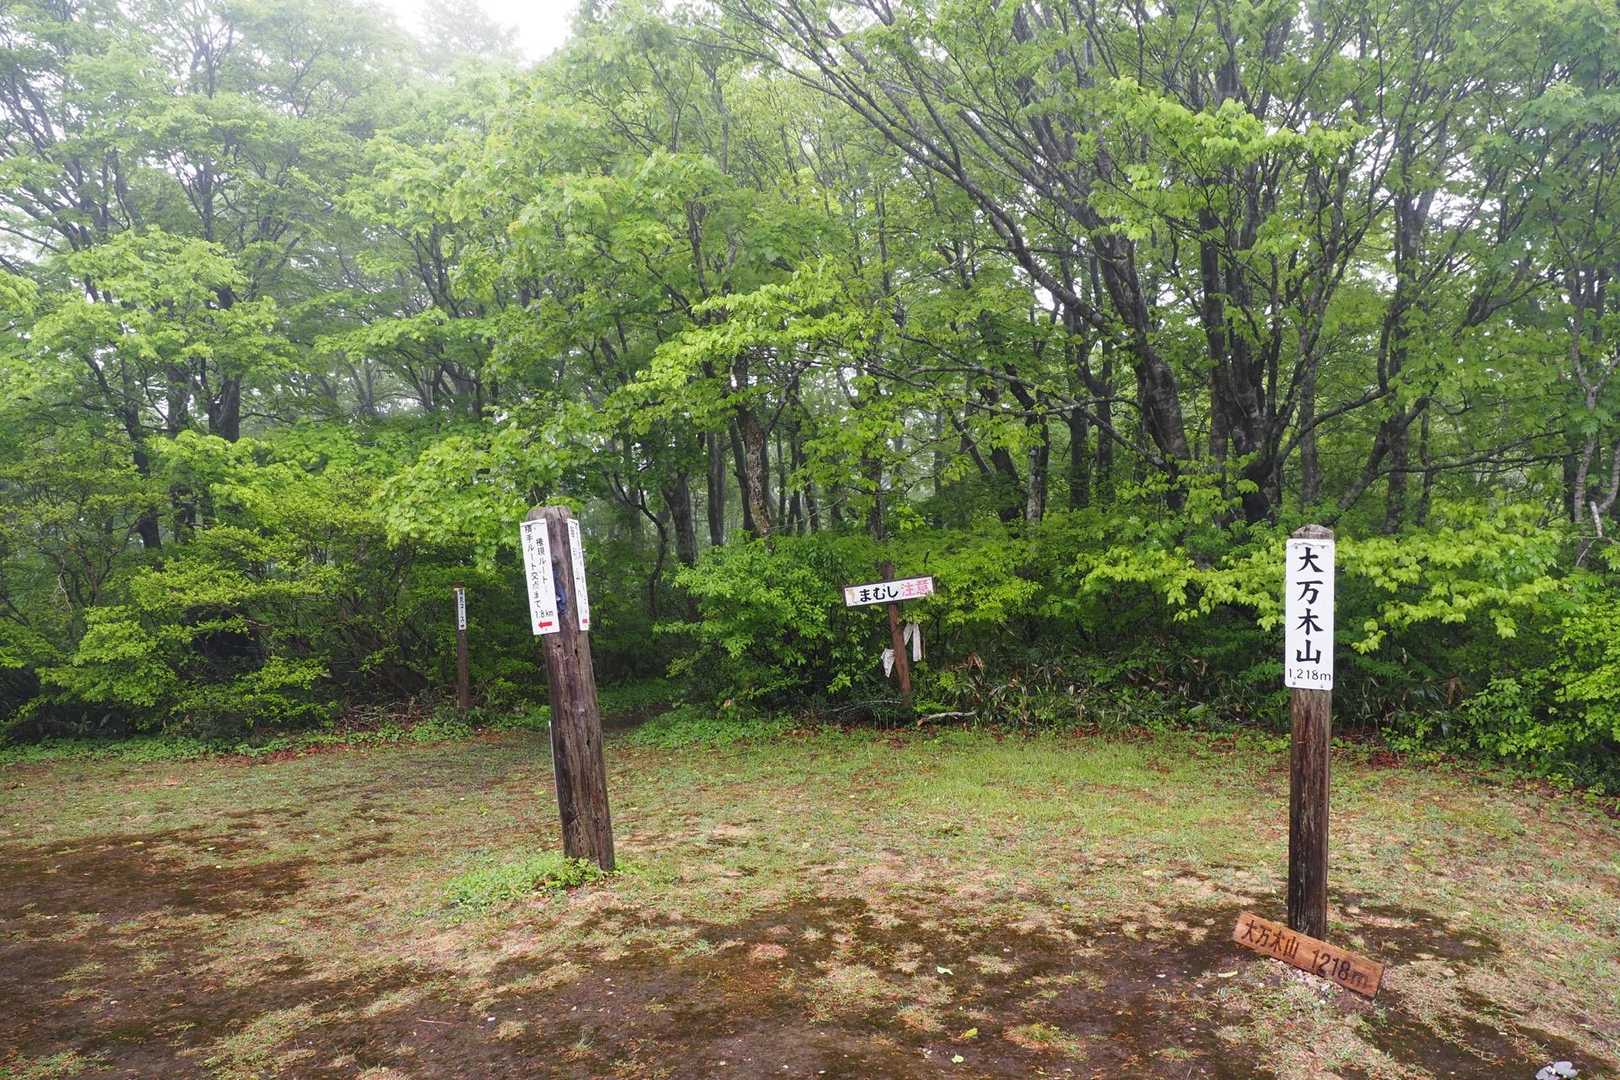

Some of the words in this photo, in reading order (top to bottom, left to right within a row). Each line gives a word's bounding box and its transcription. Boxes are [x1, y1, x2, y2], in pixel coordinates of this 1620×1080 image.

[859, 579, 929, 602] まむし注意
[1295, 546, 1325, 665] 大万木山
[1241, 919, 1300, 960] 大万木山
[1311, 949, 1370, 987] 1218m
